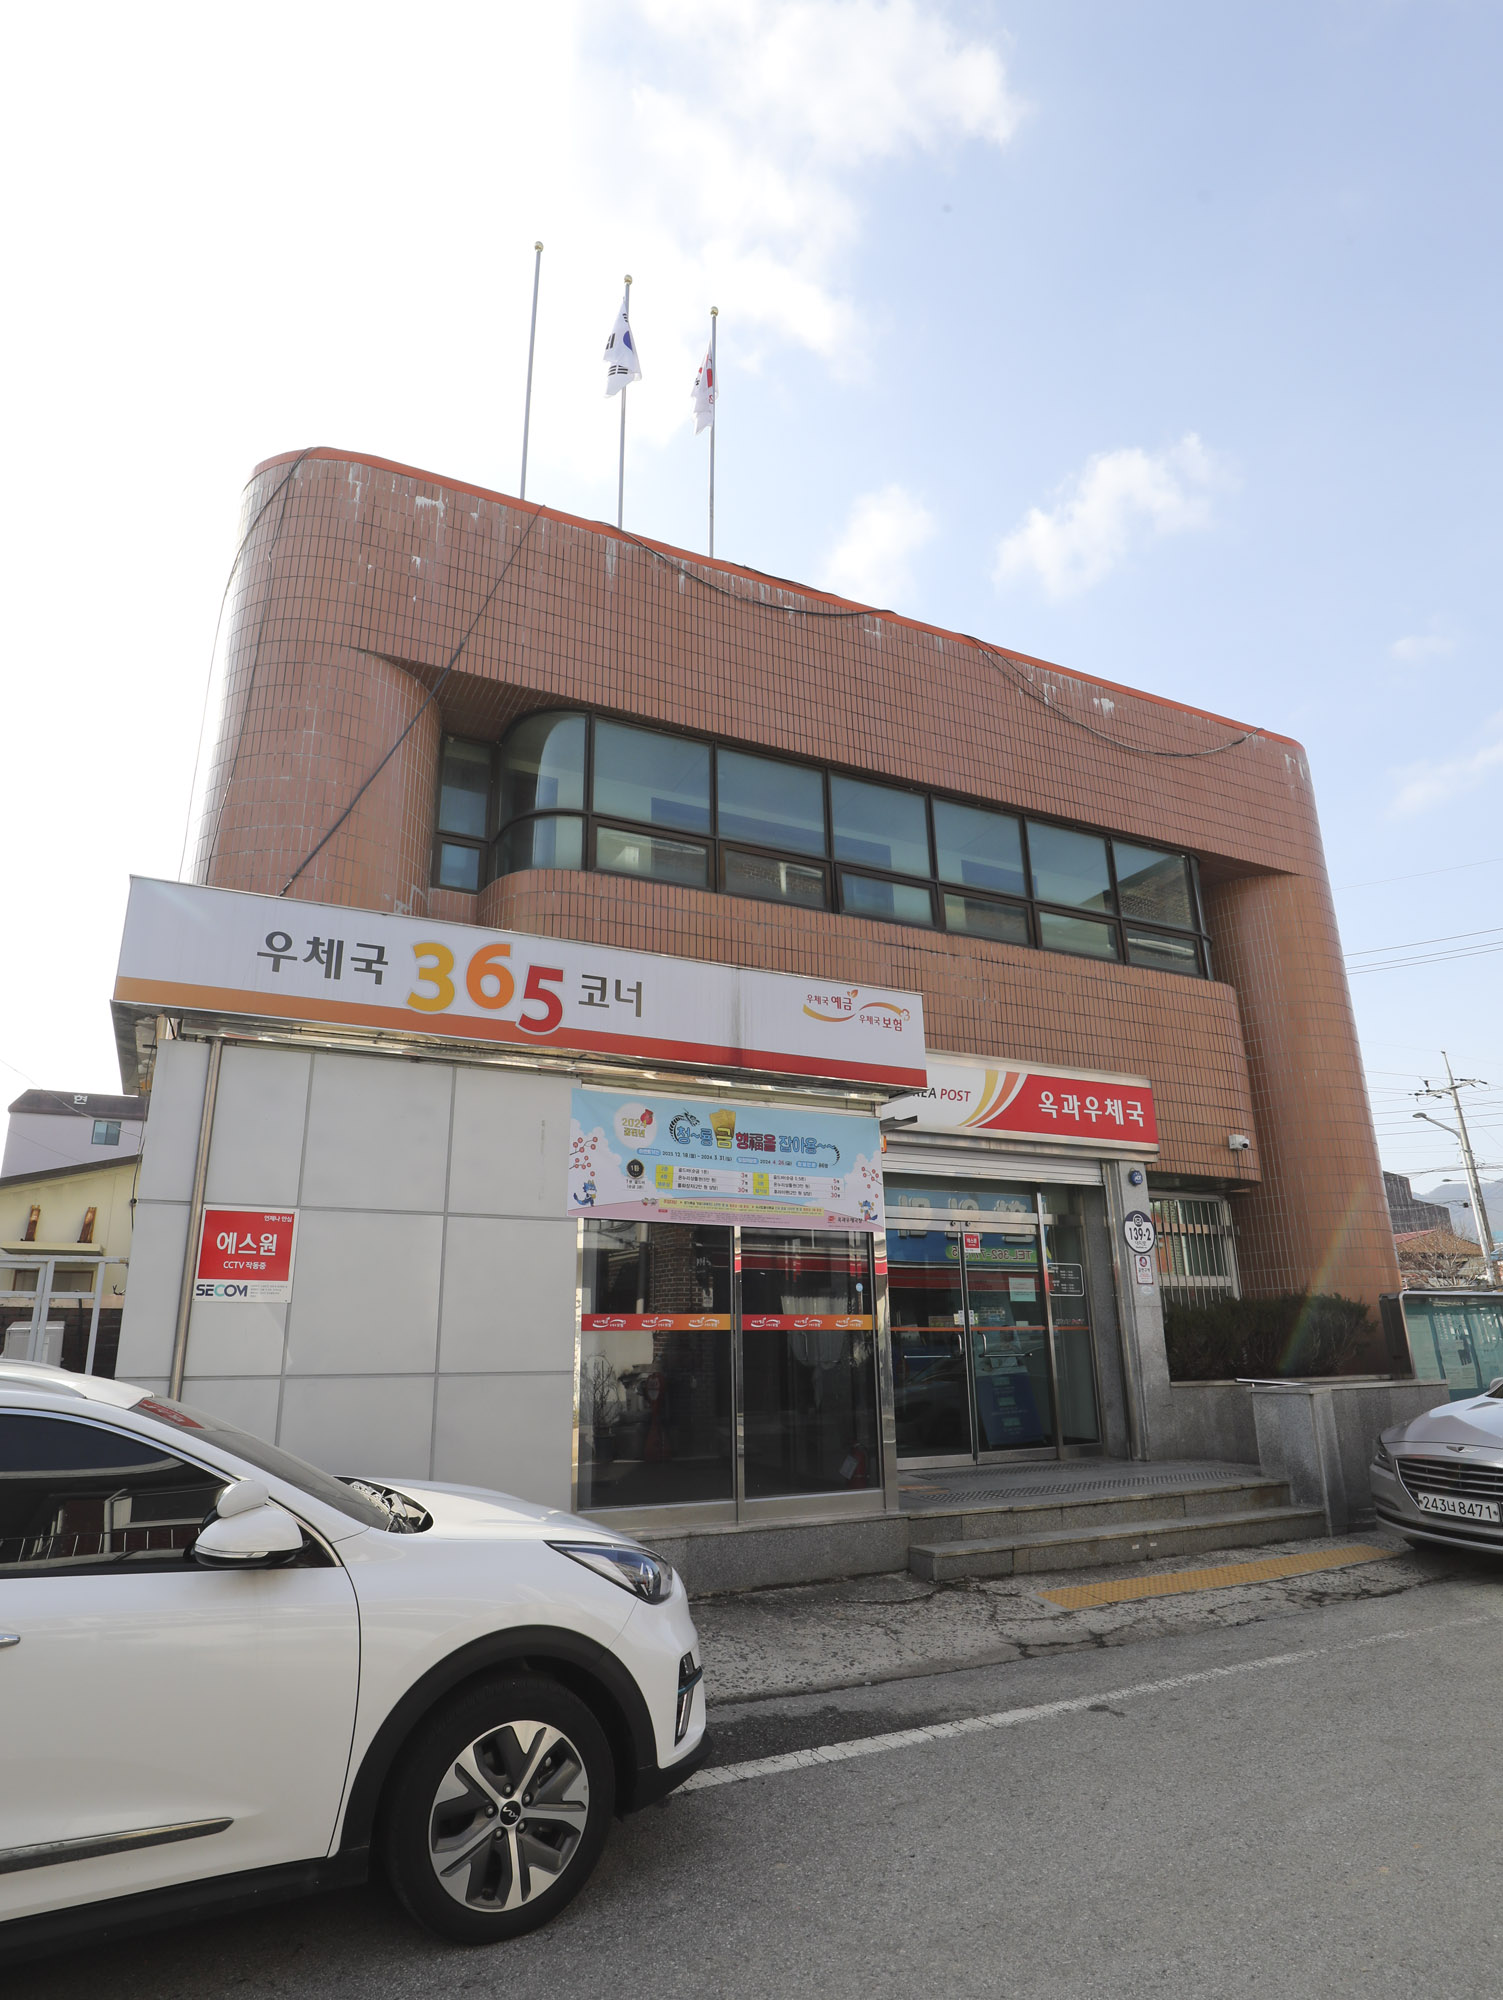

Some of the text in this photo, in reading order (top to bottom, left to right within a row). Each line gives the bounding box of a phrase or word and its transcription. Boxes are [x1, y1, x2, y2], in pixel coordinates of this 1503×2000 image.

[256, 930, 643, 1033] 우체국 365 코너
[940, 1088, 971, 1102] POST
[1038, 1091, 1144, 1127] 옥과우체국
[622, 1118, 647, 1128] 2024
[1129, 1227, 1151, 1240] 139-2
[216, 1232, 277, 1256] 에스원
[223, 1261, 266, 1270] CCTV 작동중
[196, 1284, 248, 1297] SECOM
